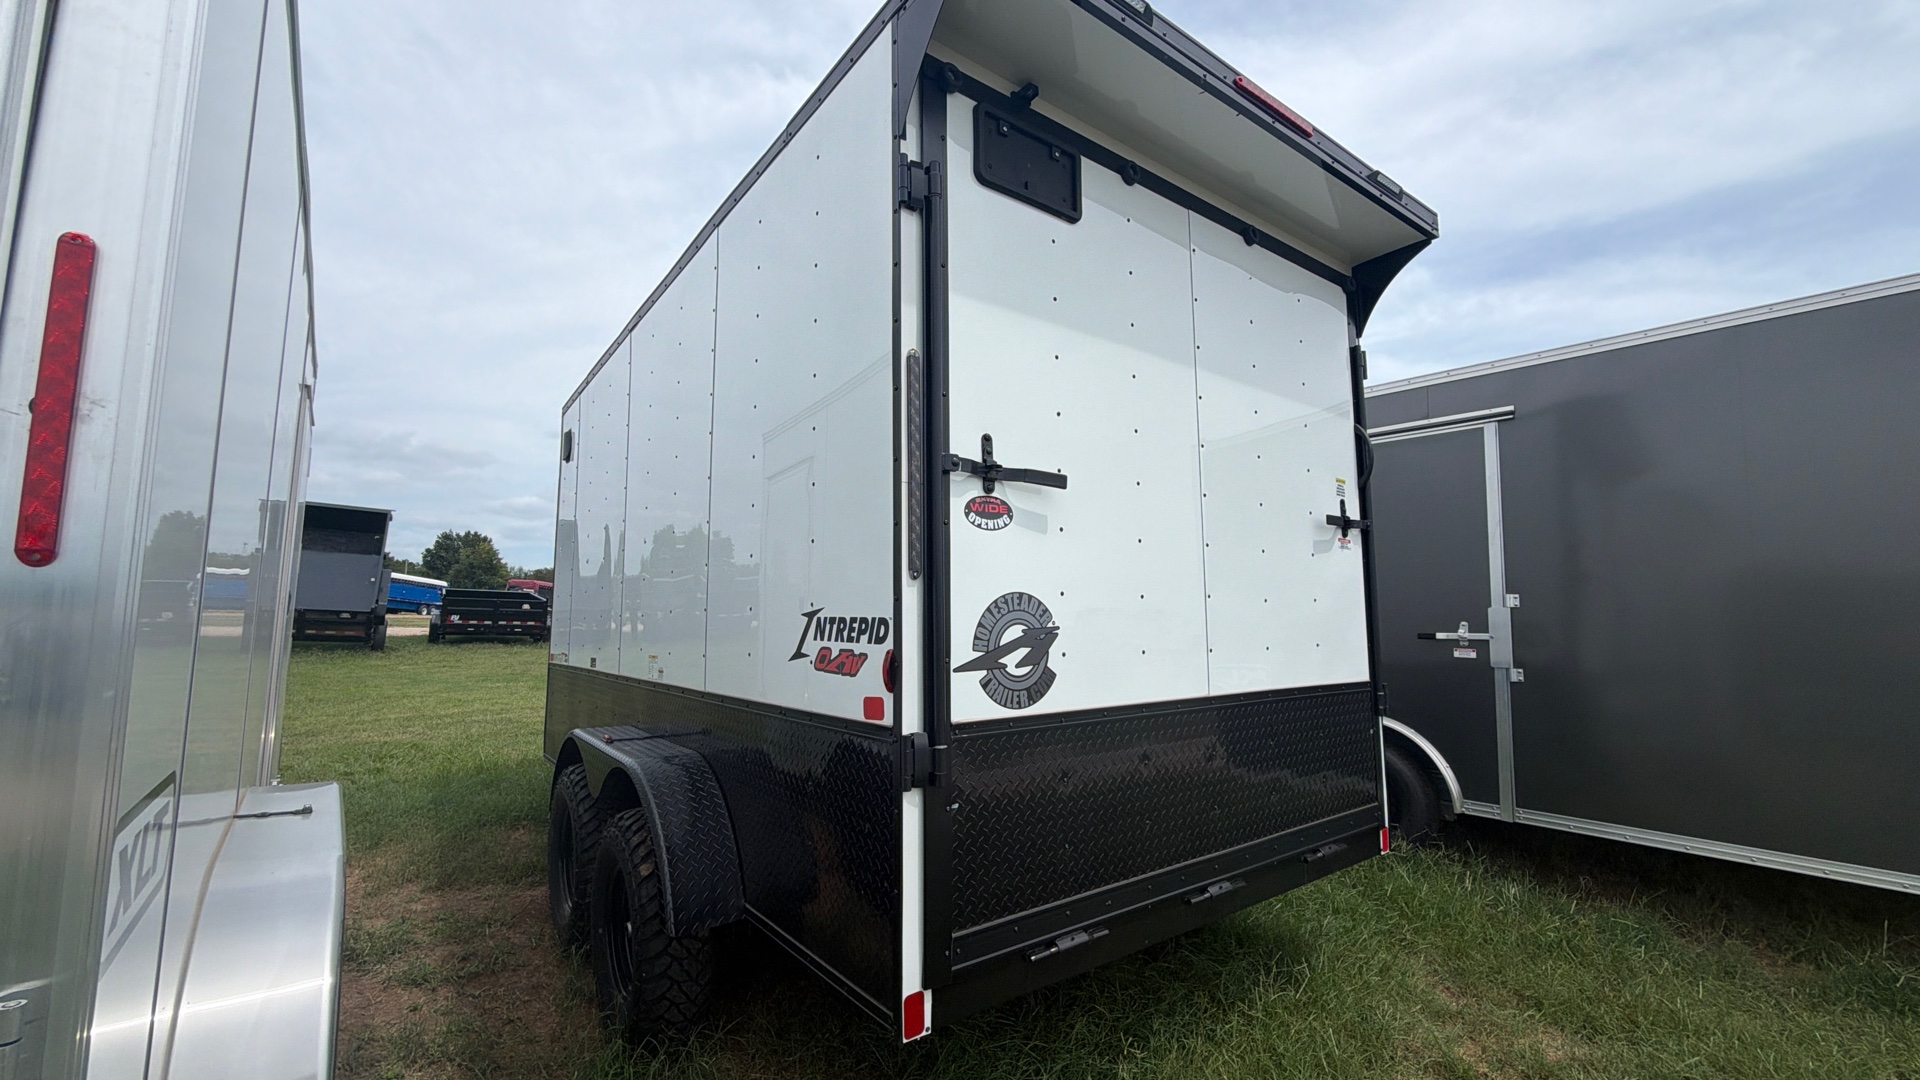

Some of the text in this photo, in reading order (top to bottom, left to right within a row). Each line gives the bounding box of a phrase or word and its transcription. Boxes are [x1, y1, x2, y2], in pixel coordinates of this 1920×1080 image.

[968, 512, 1010, 530] OPENING
[969, 502, 1009, 514] WIDE
[788, 606, 890, 662] INTREPID
[973, 593, 1053, 652] HOMESTEADER
[106, 799, 171, 940] XLT
